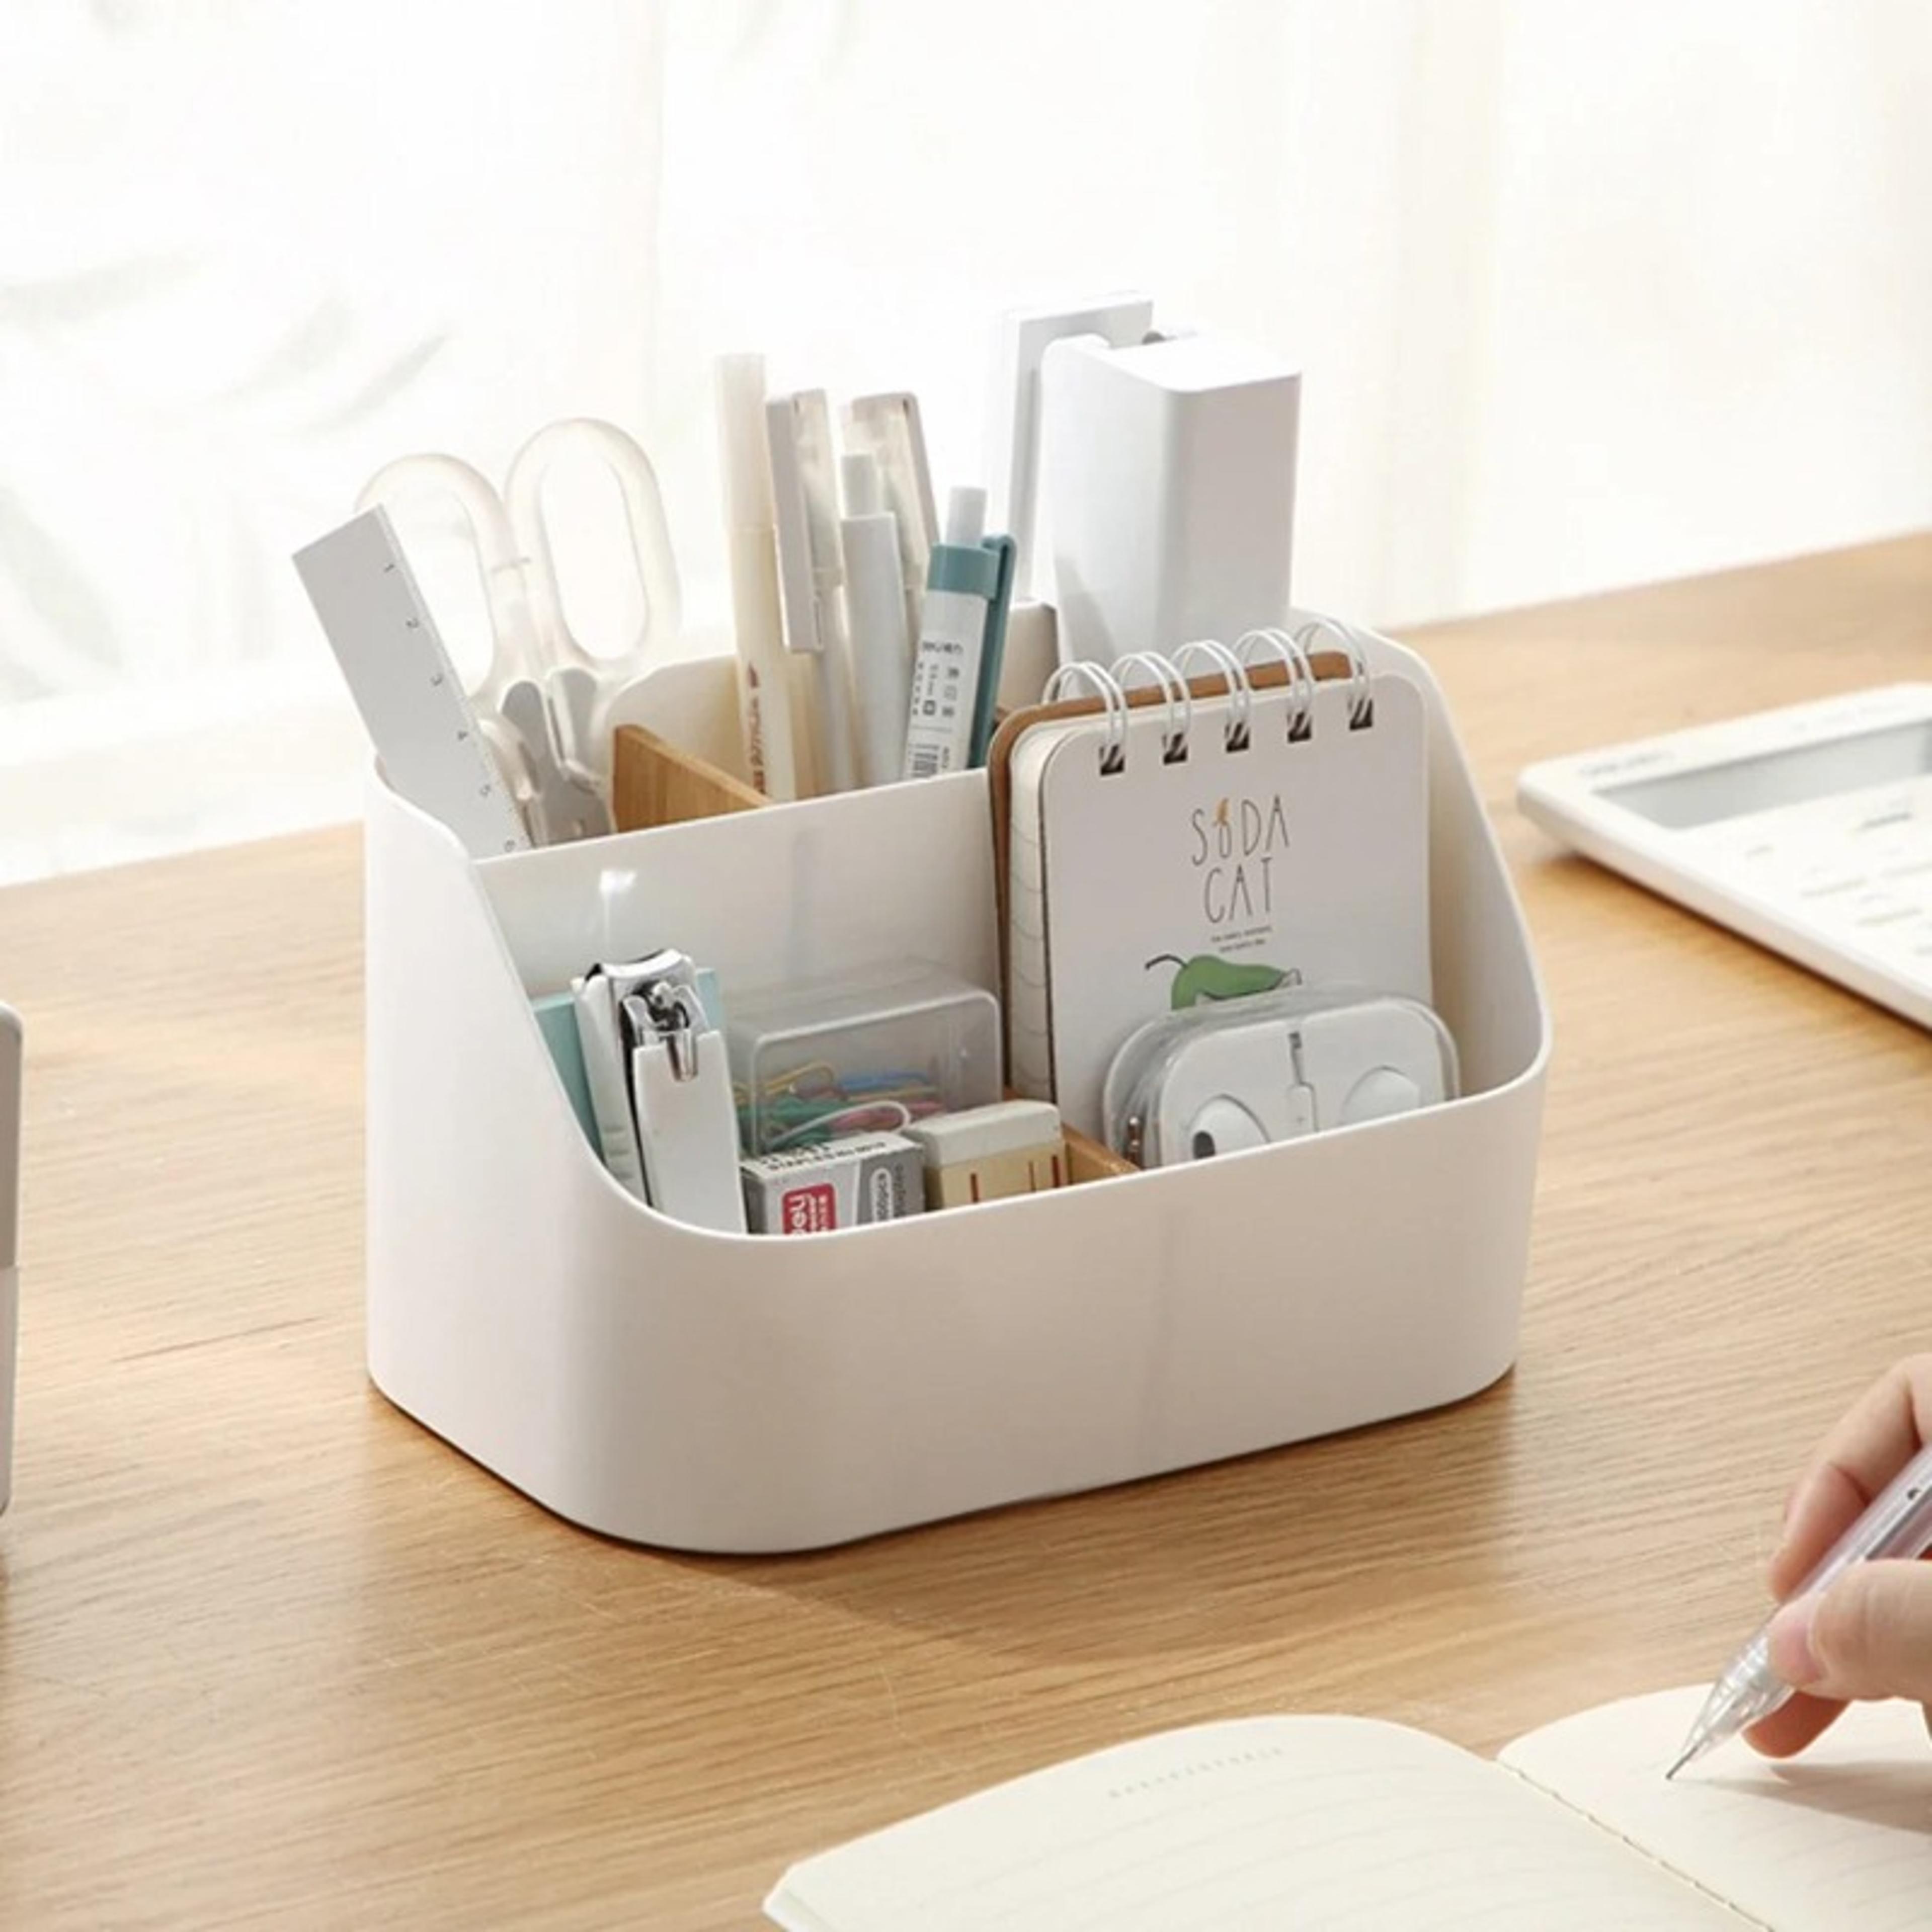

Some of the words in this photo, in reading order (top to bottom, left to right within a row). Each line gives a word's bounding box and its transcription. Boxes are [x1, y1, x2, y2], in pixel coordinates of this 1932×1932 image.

[406, 617, 419, 628] 2
[430, 673, 443, 687] 3
[457, 730, 468, 741] 4
[1191, 793, 1290, 866] SODA
[1204, 857, 1273, 924] CAT
